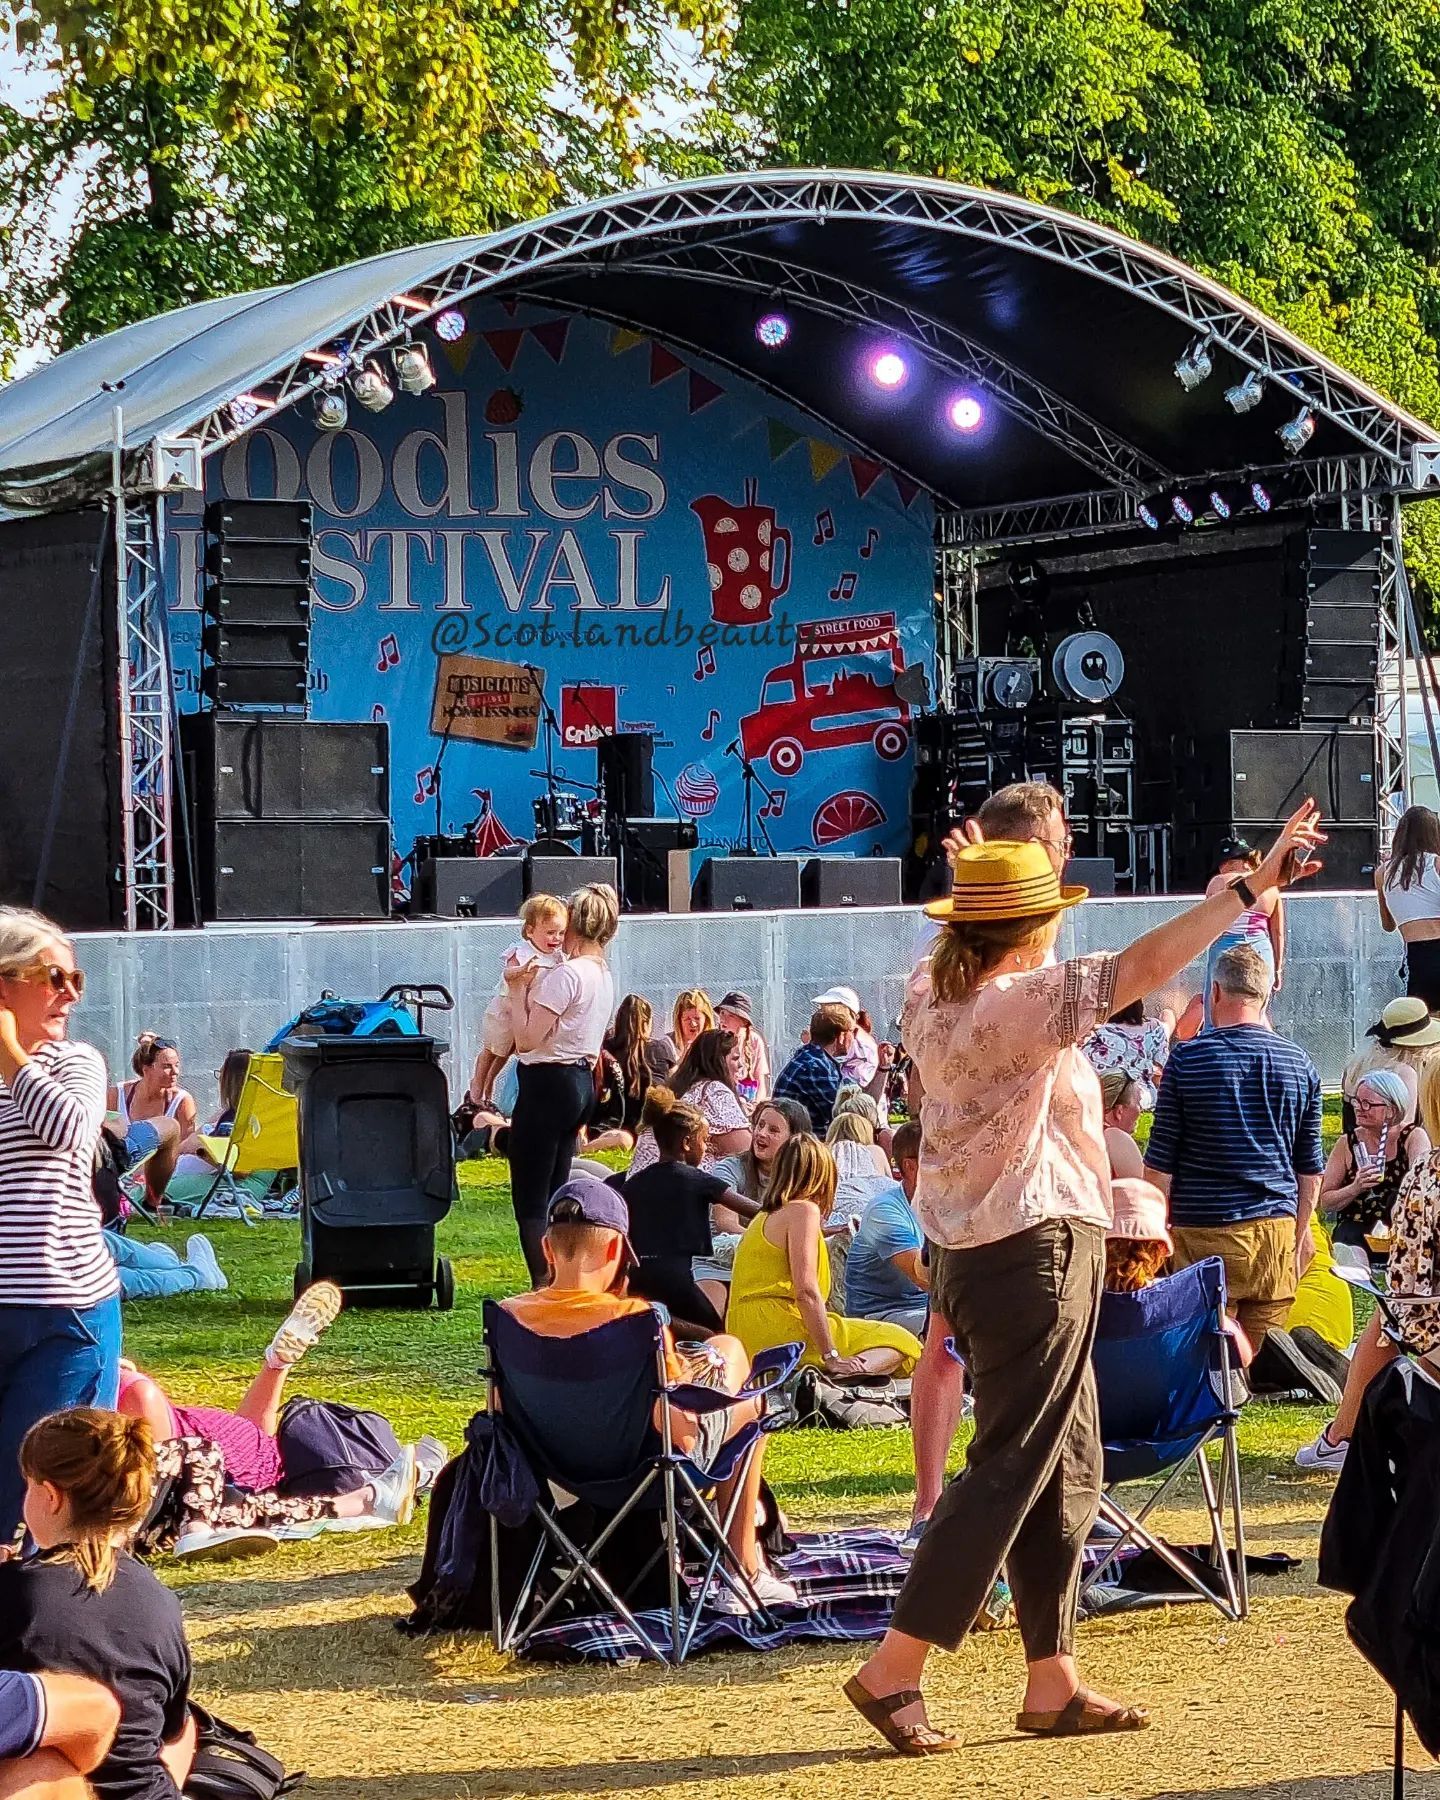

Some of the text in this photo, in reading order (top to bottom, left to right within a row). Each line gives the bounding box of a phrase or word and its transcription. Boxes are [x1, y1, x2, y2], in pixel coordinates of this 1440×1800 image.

[170, 389, 668, 521] oodies
[814, 618, 881, 635] STREET FOOD
[450, 677, 529, 693] MUSICIANS
